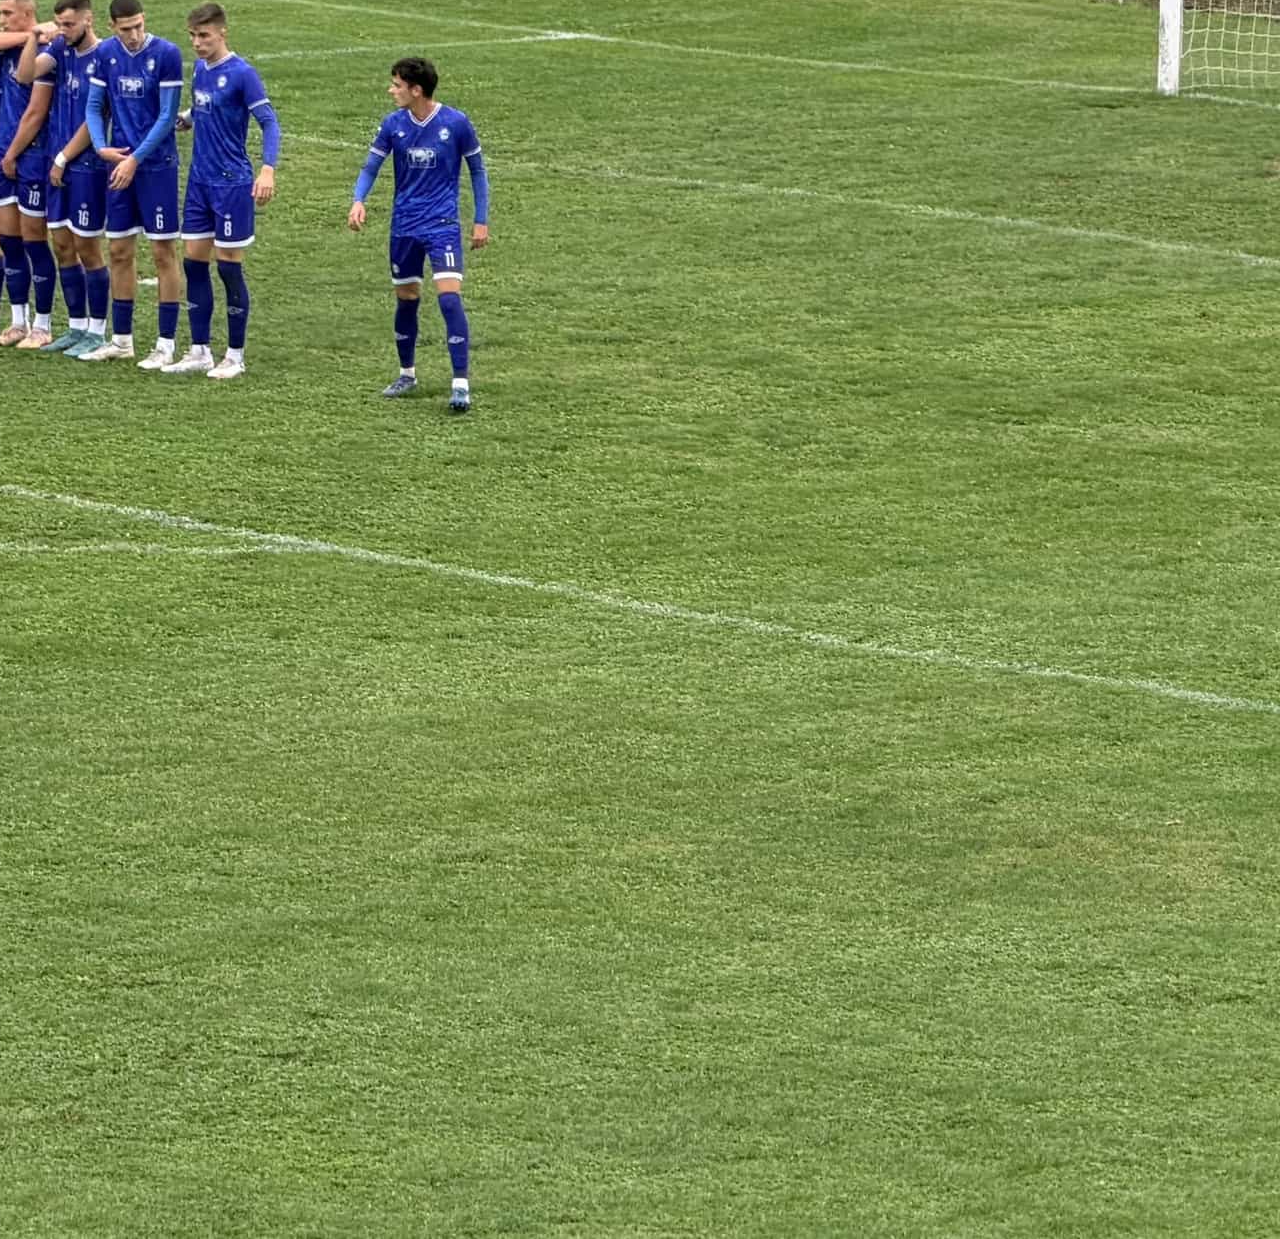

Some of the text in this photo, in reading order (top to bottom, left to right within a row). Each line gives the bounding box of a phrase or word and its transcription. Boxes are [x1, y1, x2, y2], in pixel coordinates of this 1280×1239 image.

[78, 209, 89, 226] 16
[156, 214, 163, 230] 6
[224, 221, 232, 236] 8
[444, 252, 455, 267] 11
